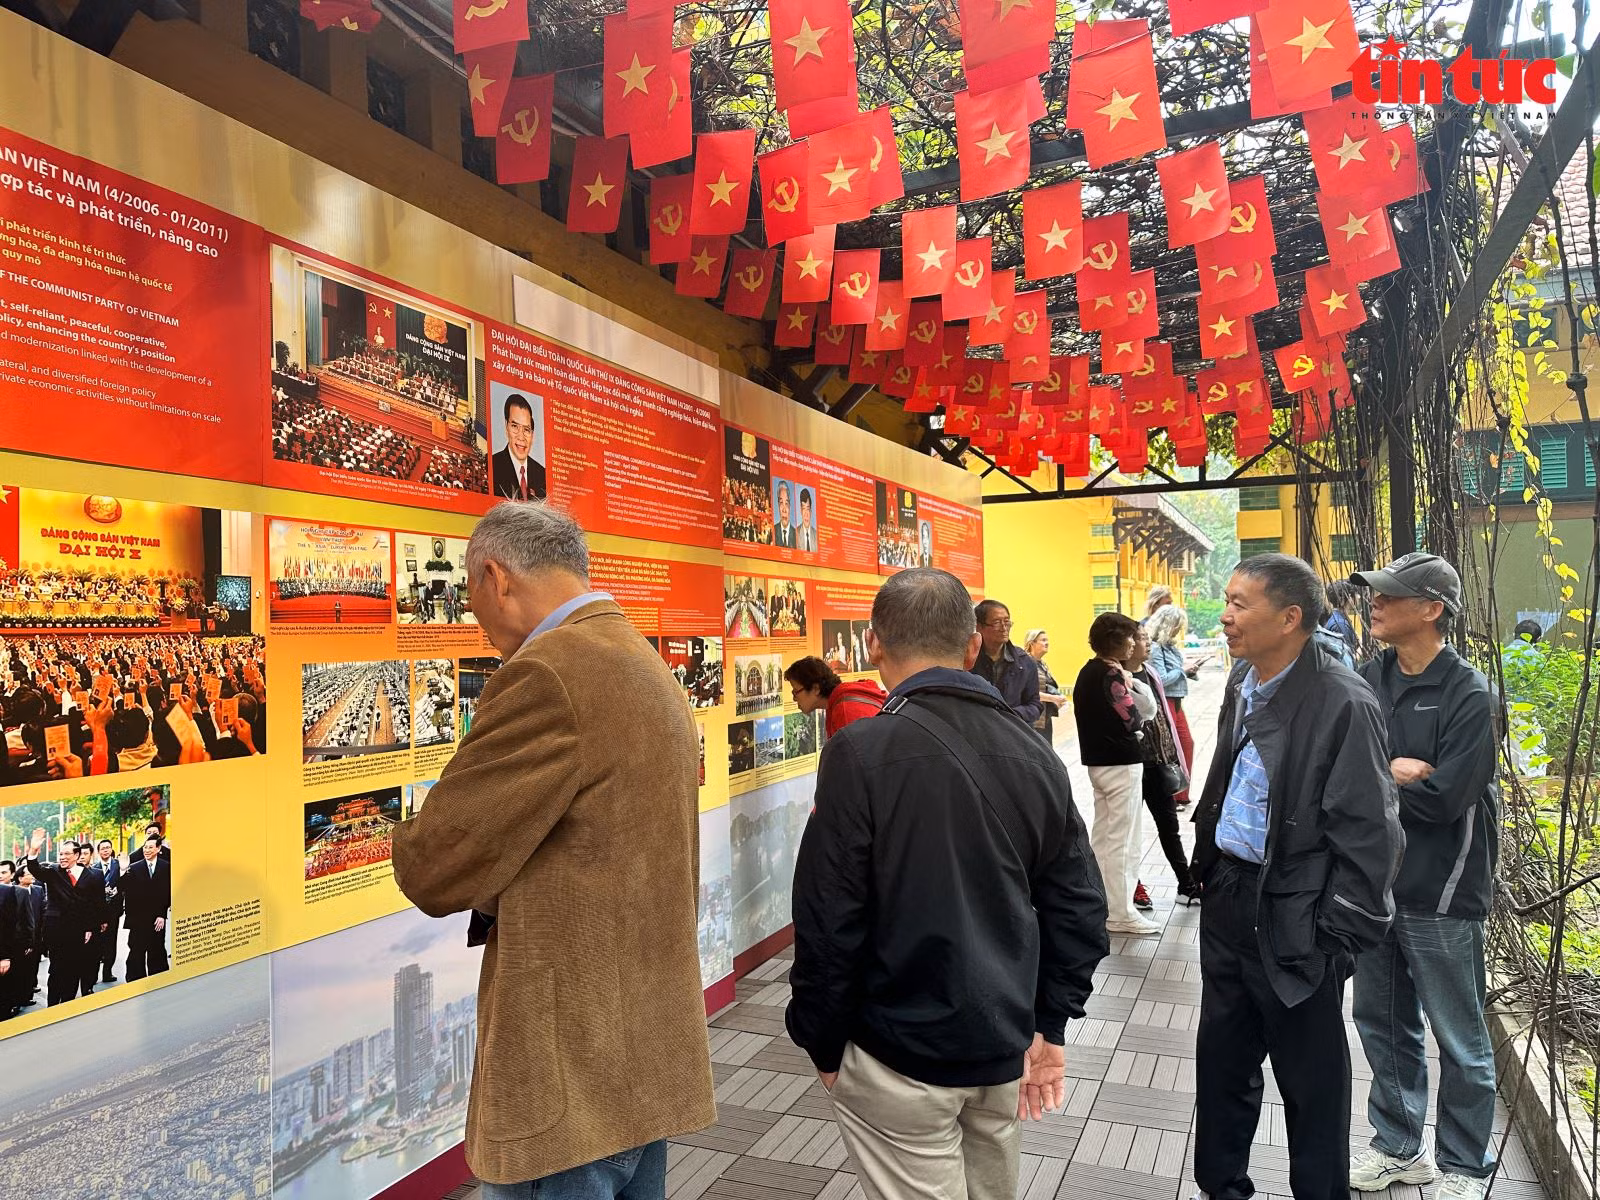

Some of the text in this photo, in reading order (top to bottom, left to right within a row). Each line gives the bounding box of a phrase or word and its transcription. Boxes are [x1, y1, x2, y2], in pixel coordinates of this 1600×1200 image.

[21, 152, 59, 179] VIỆT
[63, 171, 100, 195] NAM
[105, 184, 159, 217] (4/2006
[170, 210, 229, 243] 01/2011)
[27, 181, 52, 201] tác
[57, 192, 75, 208] và
[79, 201, 115, 222] phát
[117, 214, 156, 237] triển,
[159, 229, 193, 252] nâng
[196, 243, 218, 258] cao
[2, 248, 41, 266] quy mô
[6, 220, 31, 236] phát
[33, 228, 57, 243] triển
[59, 236, 80, 251] kinh
[82, 243, 92, 255] tế
[94, 248, 104, 258] tri
[106, 251, 127, 265] thức
[19, 236, 41, 252] hóa,
[43, 243, 56, 256] đa
[58, 248, 82, 268] dạng
[85, 257, 102, 271] hóa
[104, 264, 127, 279] quan
[129, 271, 140, 283] hệ
[142, 275, 164, 291] quốc
[165, 281, 173, 292] tế
[7, 272, 28, 286] THE
[31, 277, 93, 303] COMMUNIST
[95, 296, 124, 312] PARTY
[126, 305, 139, 316] OF
[140, 308, 179, 327] VIETNAM
[10, 301, 67, 325] self-reliant,
[70, 317, 112, 336] peaceful,
[114, 329, 167, 350] cooperative,
[27, 320, 79, 340] enhancing
[81, 332, 96, 344] the
[99, 337, 139, 354] country's
[141, 347, 175, 363] position
[11, 331, 79, 355] modernization
[81, 348, 108, 363] linked
[110, 355, 128, 367] with
[130, 360, 144, 371] the
[146, 364, 196, 384] development
[198, 375, 206, 385] of
[28, 378, 74, 394] economic
[76, 387, 114, 402] activities
[116, 395, 148, 409] without
[150, 402, 190, 417] limitations
[192, 411, 201, 419] on
[203, 412, 221, 423] scale
[32, 364, 49, 376] and
[52, 368, 98, 386] diversified
[100, 378, 130, 393] foreign
[132, 385, 157, 399] policy
[40, 526, 160, 548] ĐẢNG CỘNG SẢN VIỆT NAM
[59, 542, 91, 558] ĐẠI
[96, 544, 125, 561] HỘI
